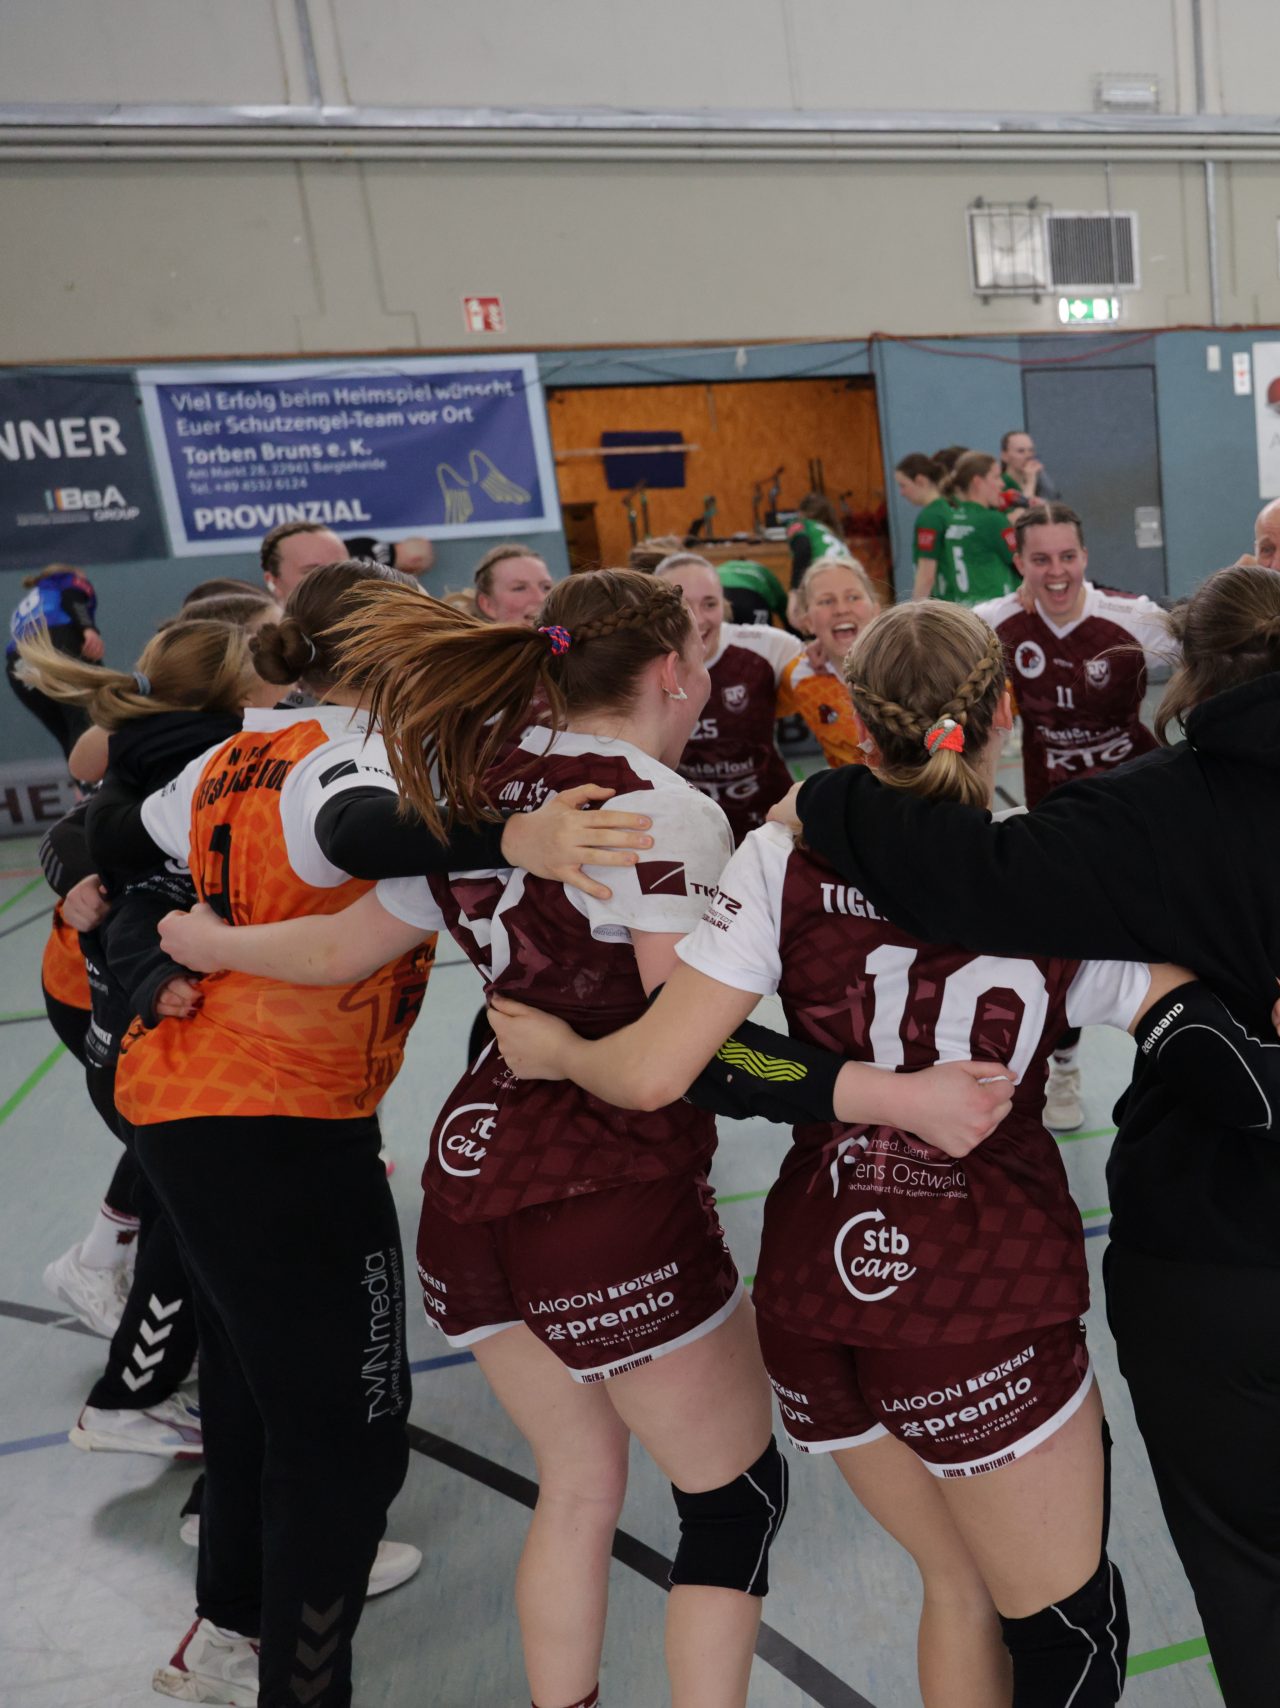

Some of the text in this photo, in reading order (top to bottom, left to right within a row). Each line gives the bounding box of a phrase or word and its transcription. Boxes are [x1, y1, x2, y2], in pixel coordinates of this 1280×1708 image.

[171, 380, 515, 413] Viel Erfolg beim Heimspiel wünscht
[176, 405, 475, 437] Euer Schutzengel-Team vor Ort
[183, 438, 373, 465] Torben Bruns e. K.
[194, 499, 372, 533] PROVINZIAL
[1056, 685, 1075, 709] 11
[1046, 732, 1134, 771] KTG
[865, 943, 1050, 1086] 10
[872, 1138, 931, 1161] med. dent.
[893, 1185, 905, 1195] für
[863, 1226, 910, 1256] stb
[850, 1256, 918, 1282] care
[529, 1262, 679, 1315] LAIQON TOKEN
[566, 1290, 675, 1340] premio
[622, 1310, 681, 1336] AUTOSERVICE
[360, 1250, 391, 1424] TWIN media
[635, 1326, 660, 1338] GMBH
[581, 1371, 605, 1384] TIGERS
[881, 1345, 1036, 1412] LAIQON TOKEN
[923, 1377, 1032, 1436] premio
[982, 1396, 1039, 1431] AUTOSERVICE
[962, 1416, 1019, 1445] HOLST GMBH
[942, 1468, 966, 1478] TIGERS
